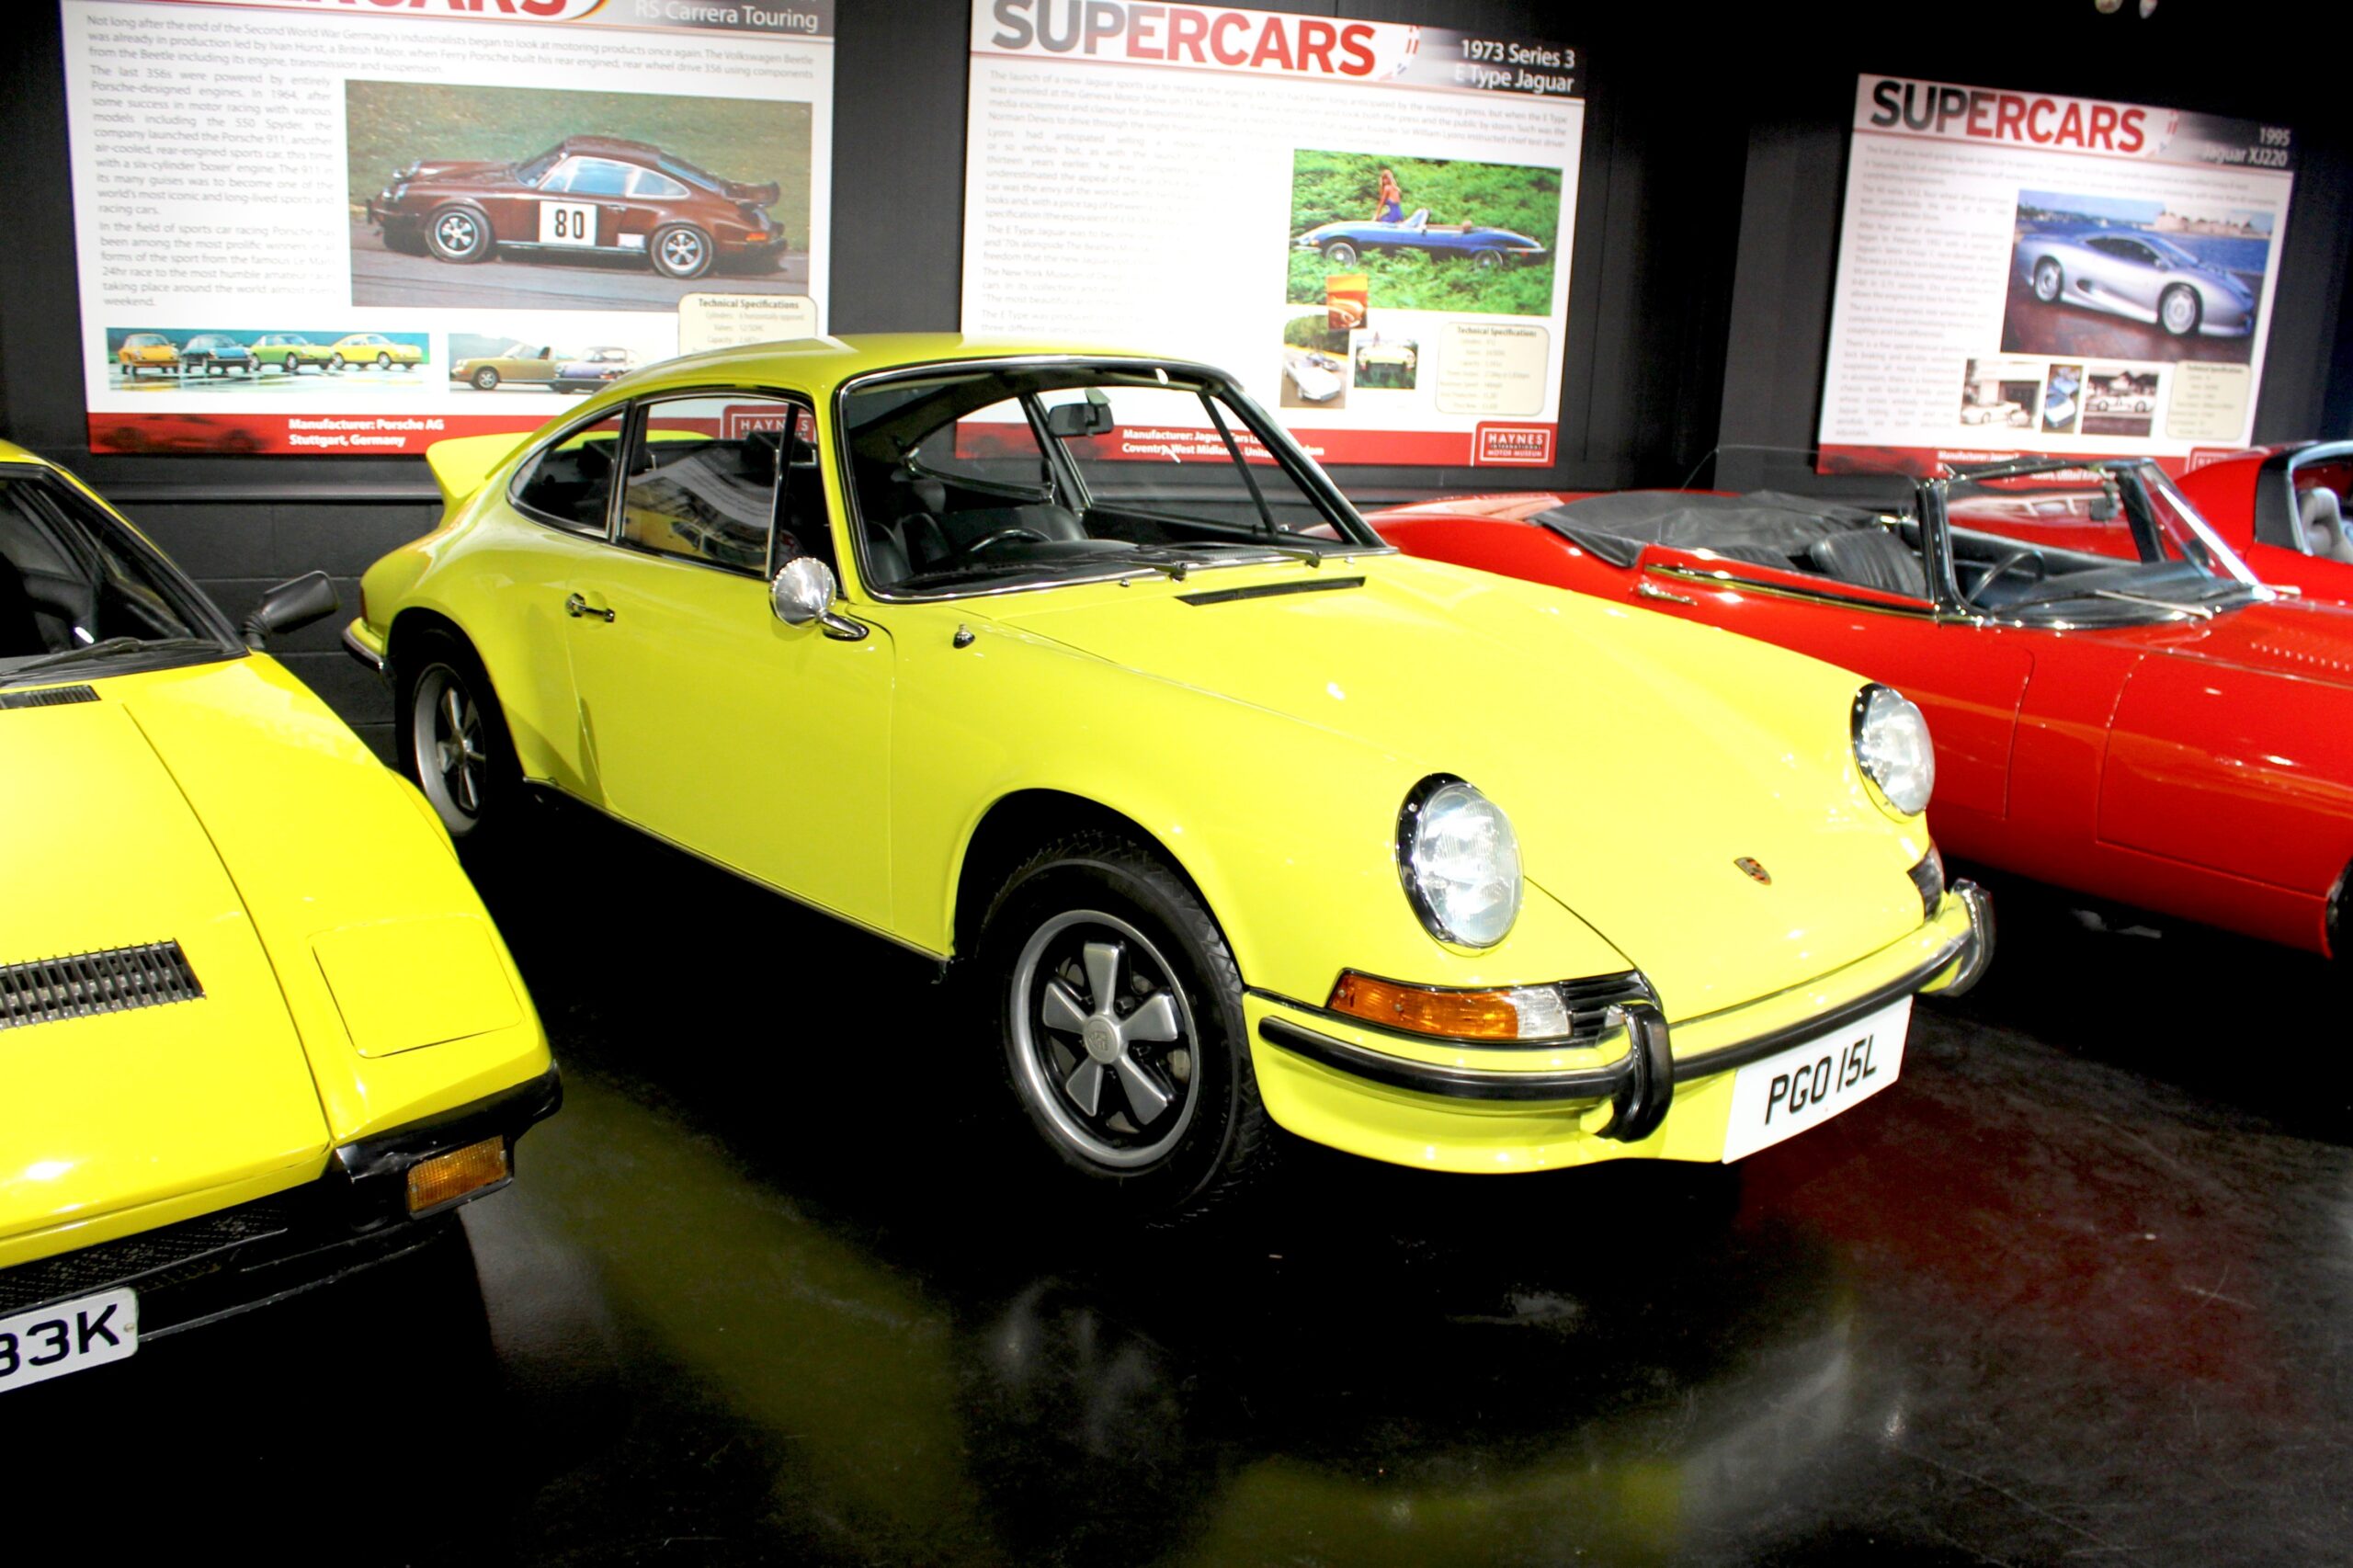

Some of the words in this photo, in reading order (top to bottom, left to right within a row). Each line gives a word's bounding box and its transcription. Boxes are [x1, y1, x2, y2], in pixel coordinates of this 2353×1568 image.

[635, 1, 660, 18] RS
[665, 5, 738, 24] Carrera
[742, 6, 818, 33] Touring
[991, 0, 1376, 76] SUPERCARS
[1461, 40, 1504, 62] 1973
[1507, 43, 1561, 67] Series
[1563, 49, 1575, 68] 3
[1456, 63, 1465, 84] E
[1468, 64, 1512, 89] Type
[1514, 68, 1574, 95] Jaguar
[1870, 80, 2146, 153] SUPERCARS
[2260, 127, 2290, 146] 1995
[2248, 147, 2288, 166] XJ220
[555, 208, 584, 239] 80
[699, 298, 738, 308] Technical
[740, 299, 799, 310] Specifications
[289, 419, 374, 430] Manufacturer:
[376, 418, 424, 430] Porsche
[426, 419, 444, 430] AG
[741, 419, 809, 431] HAYNS
[289, 434, 348, 448] Stuttgart,
[349, 434, 406, 448] Germany
[1122, 428, 1193, 440] Manufacturer:
[1489, 433, 1543, 445] HAYNES
[1171, 444, 1194, 454] West
[1766, 1056, 1832, 1125] PGO
[1836, 1034, 1877, 1093] 15L
